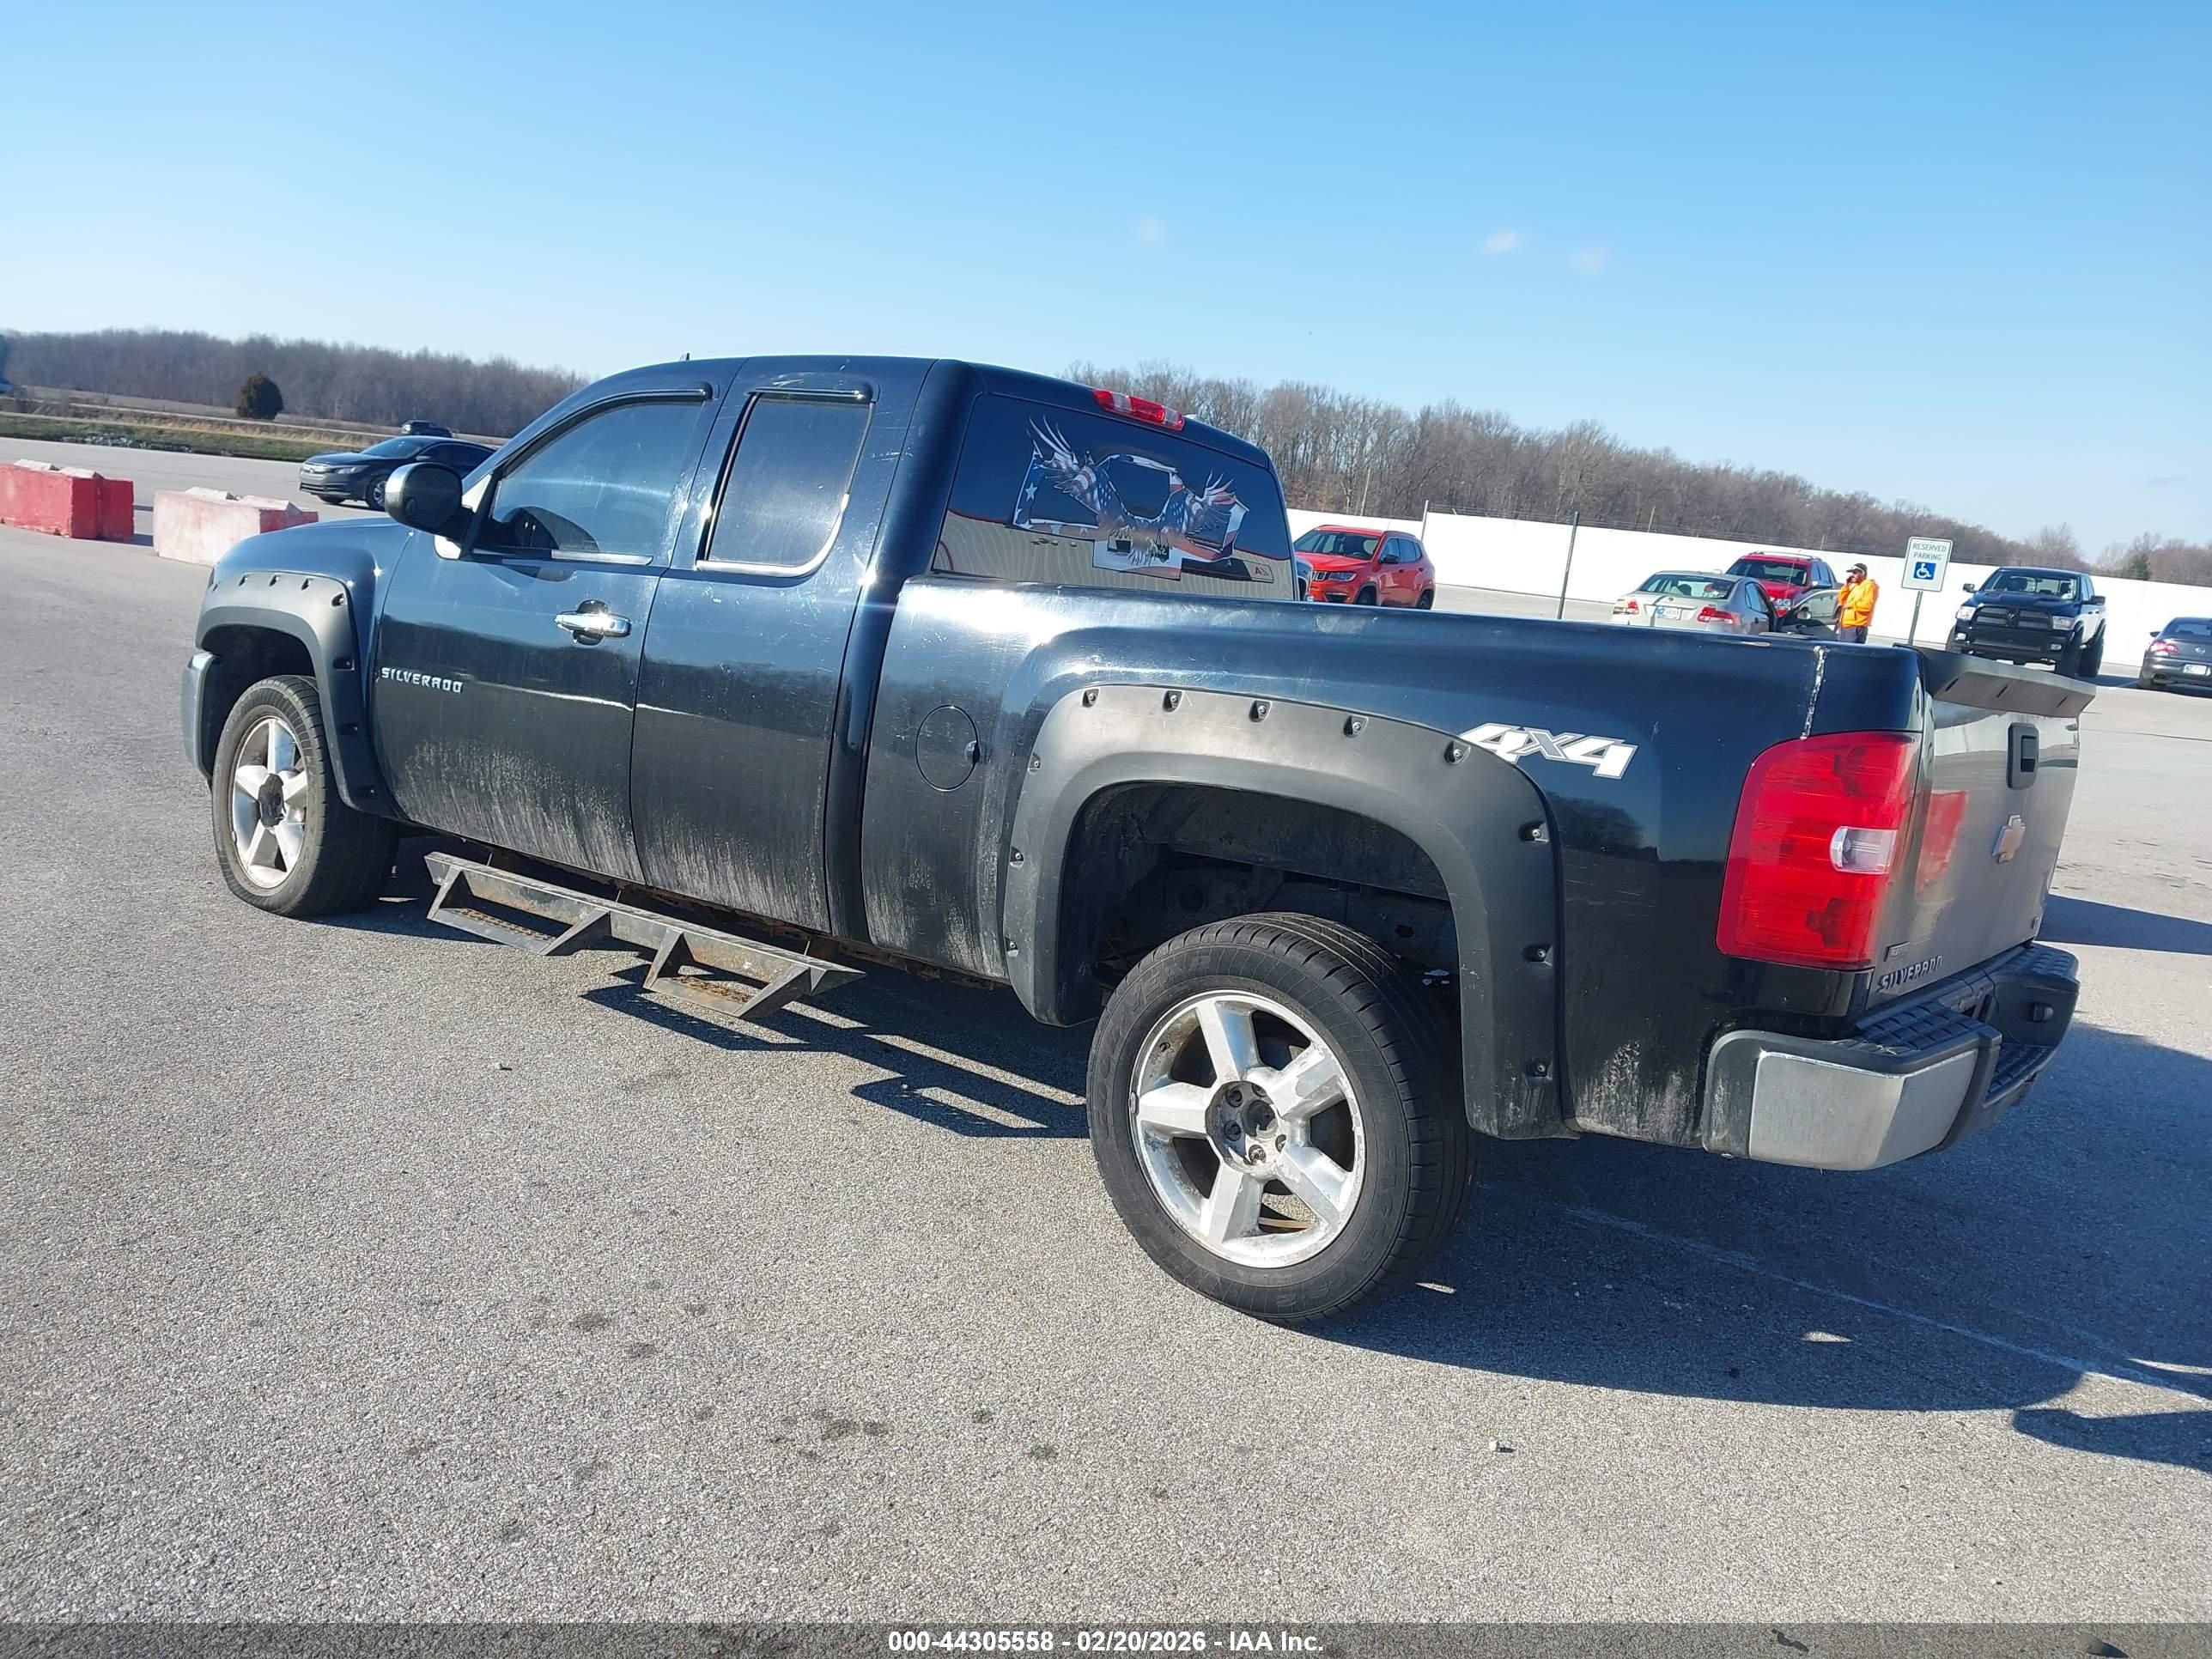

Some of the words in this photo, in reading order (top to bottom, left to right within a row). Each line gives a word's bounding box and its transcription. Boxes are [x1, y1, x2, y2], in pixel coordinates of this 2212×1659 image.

[1913, 552, 1942, 561] PARKING
[381, 667, 464, 693] SILVERADO
[1880, 956, 1942, 989] SILVERADO
